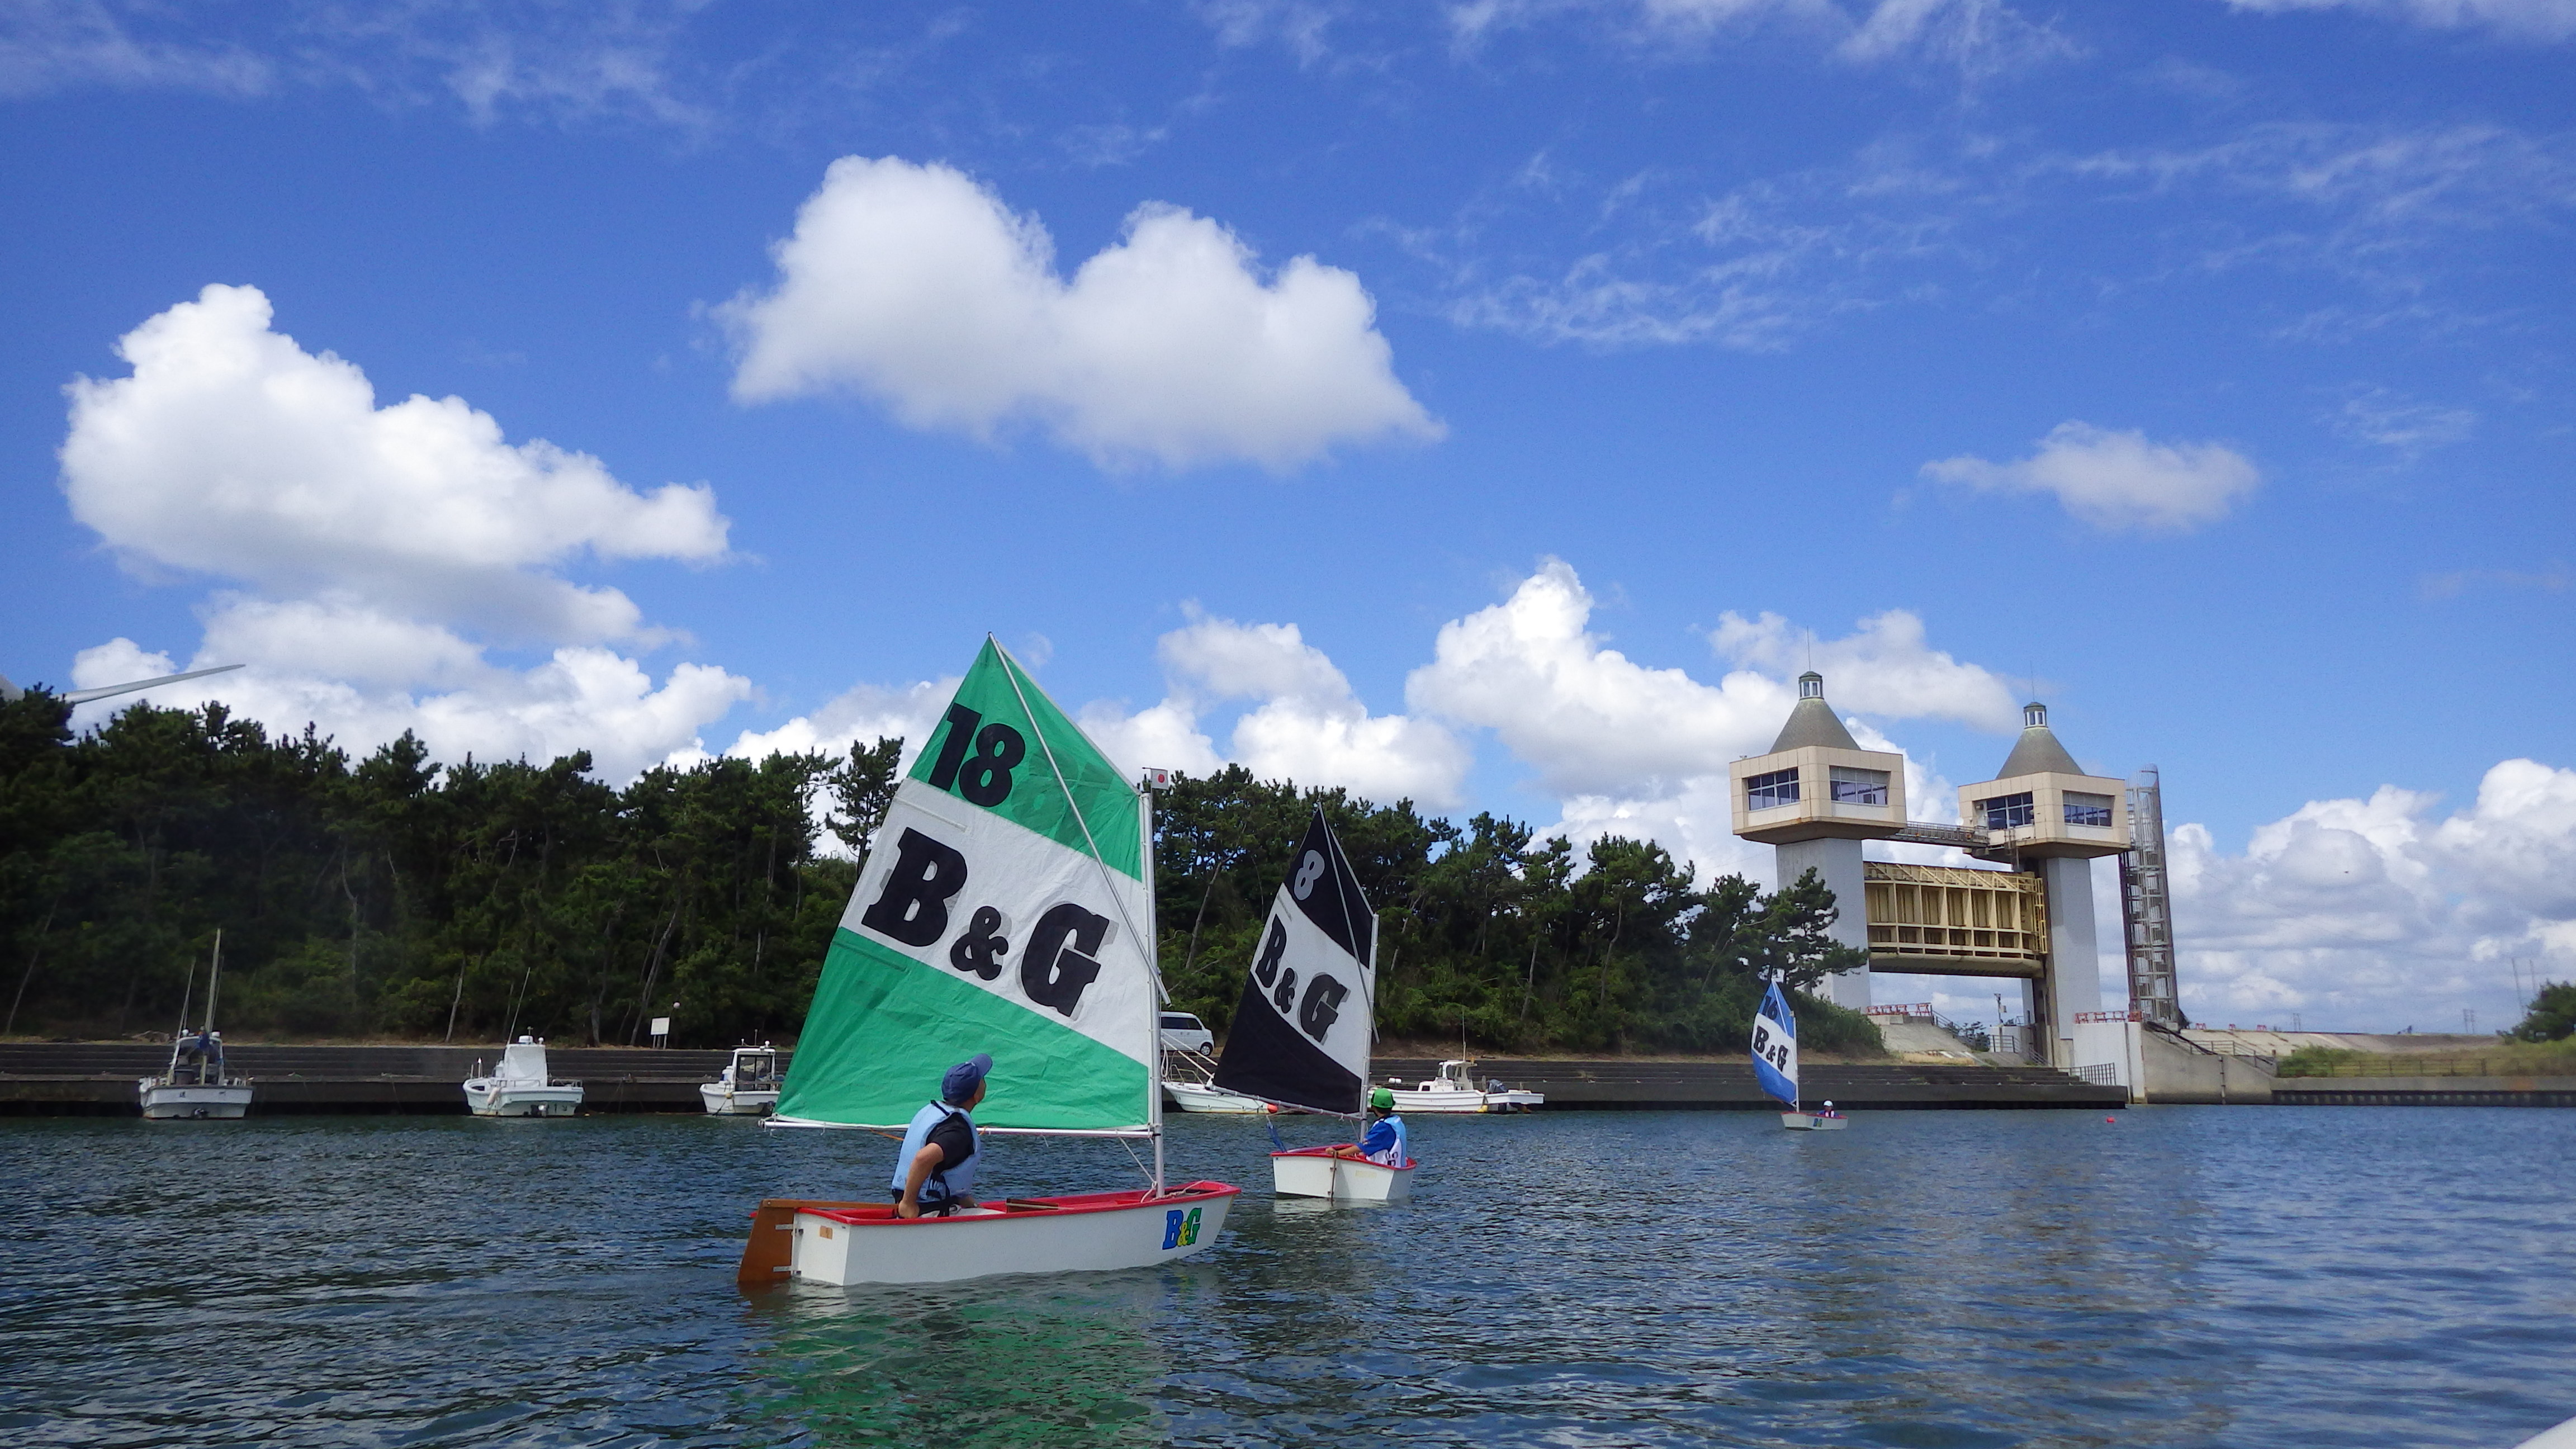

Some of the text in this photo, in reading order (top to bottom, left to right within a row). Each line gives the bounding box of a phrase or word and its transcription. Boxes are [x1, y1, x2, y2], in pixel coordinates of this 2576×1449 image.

[928, 703, 1025, 807] 18
[1294, 849, 1325, 901] 8
[1761, 996, 1778, 1020] 16
[1162, 1208, 1202, 1250] B&G
